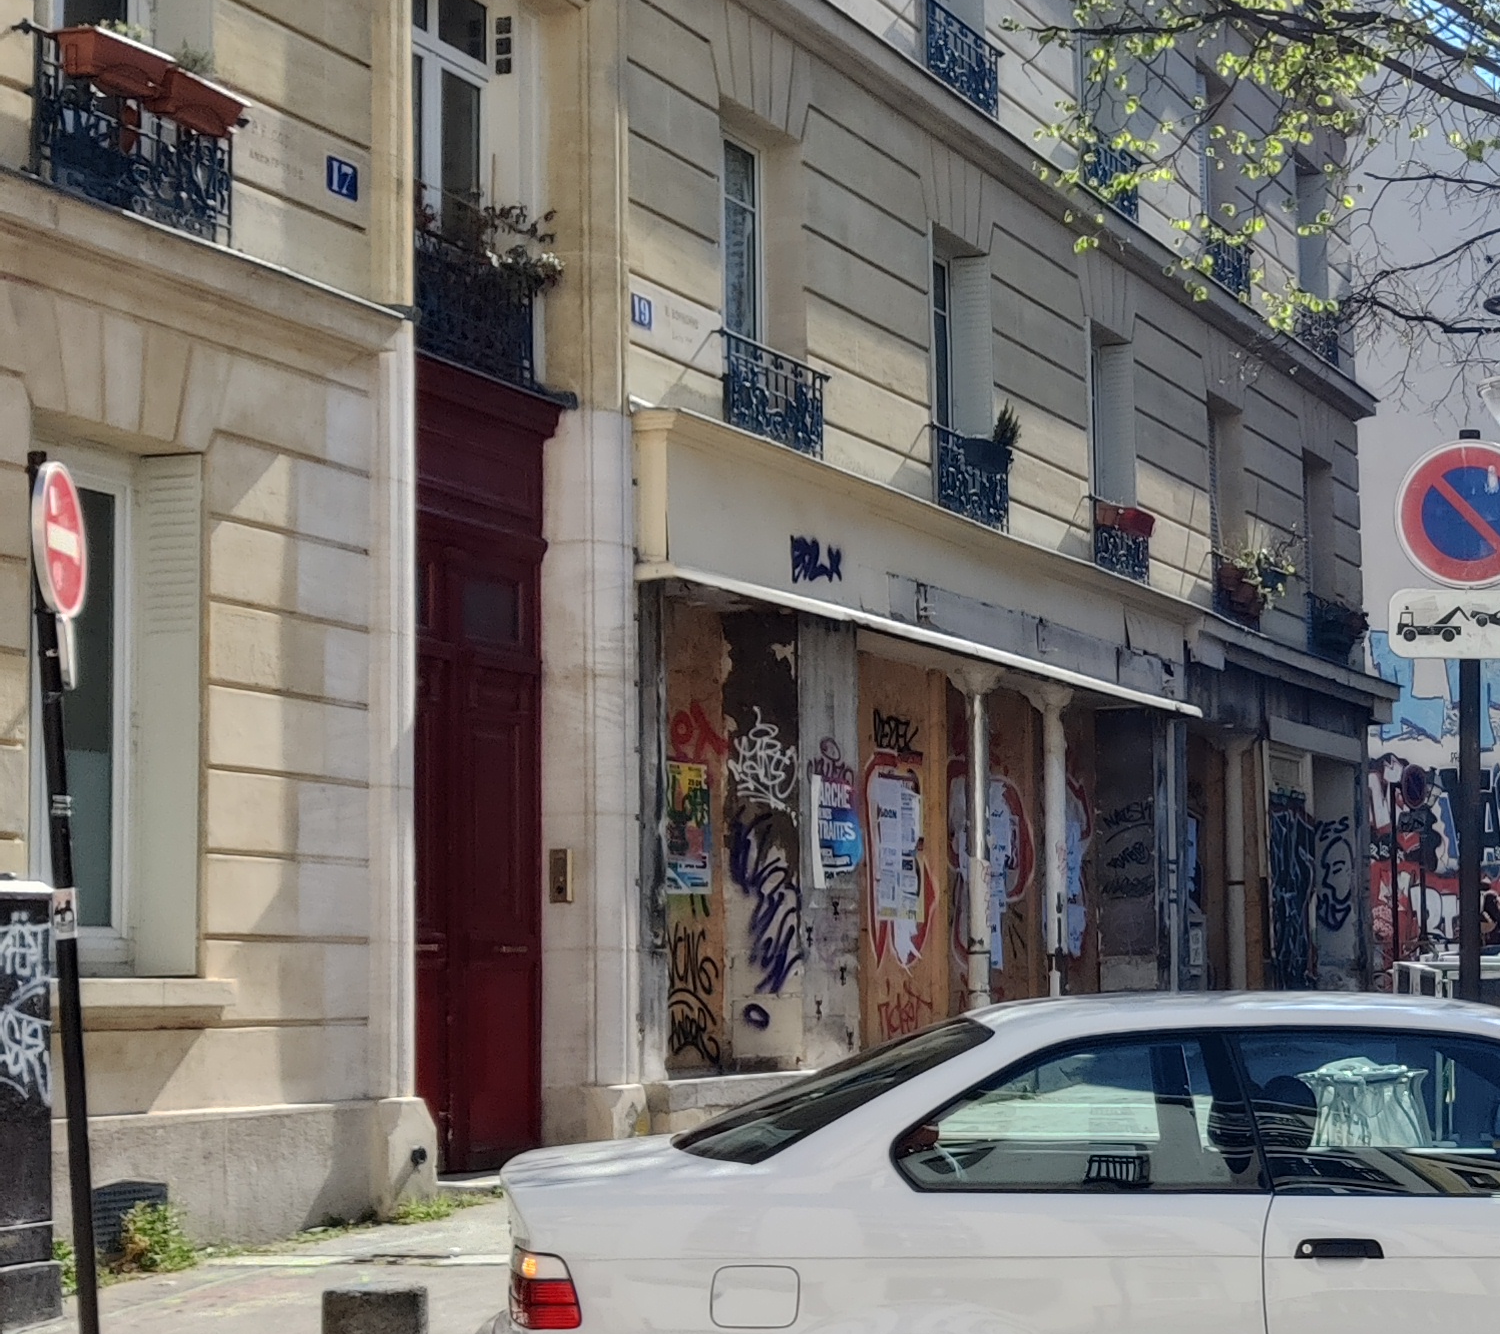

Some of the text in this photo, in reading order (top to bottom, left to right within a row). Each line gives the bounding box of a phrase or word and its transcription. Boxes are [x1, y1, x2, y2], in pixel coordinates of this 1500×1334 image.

[332, 160, 354, 195] 17
[633, 295, 650, 325] 19
[819, 781, 851, 809] ARCHE
[819, 820, 856, 841] TRAITES
